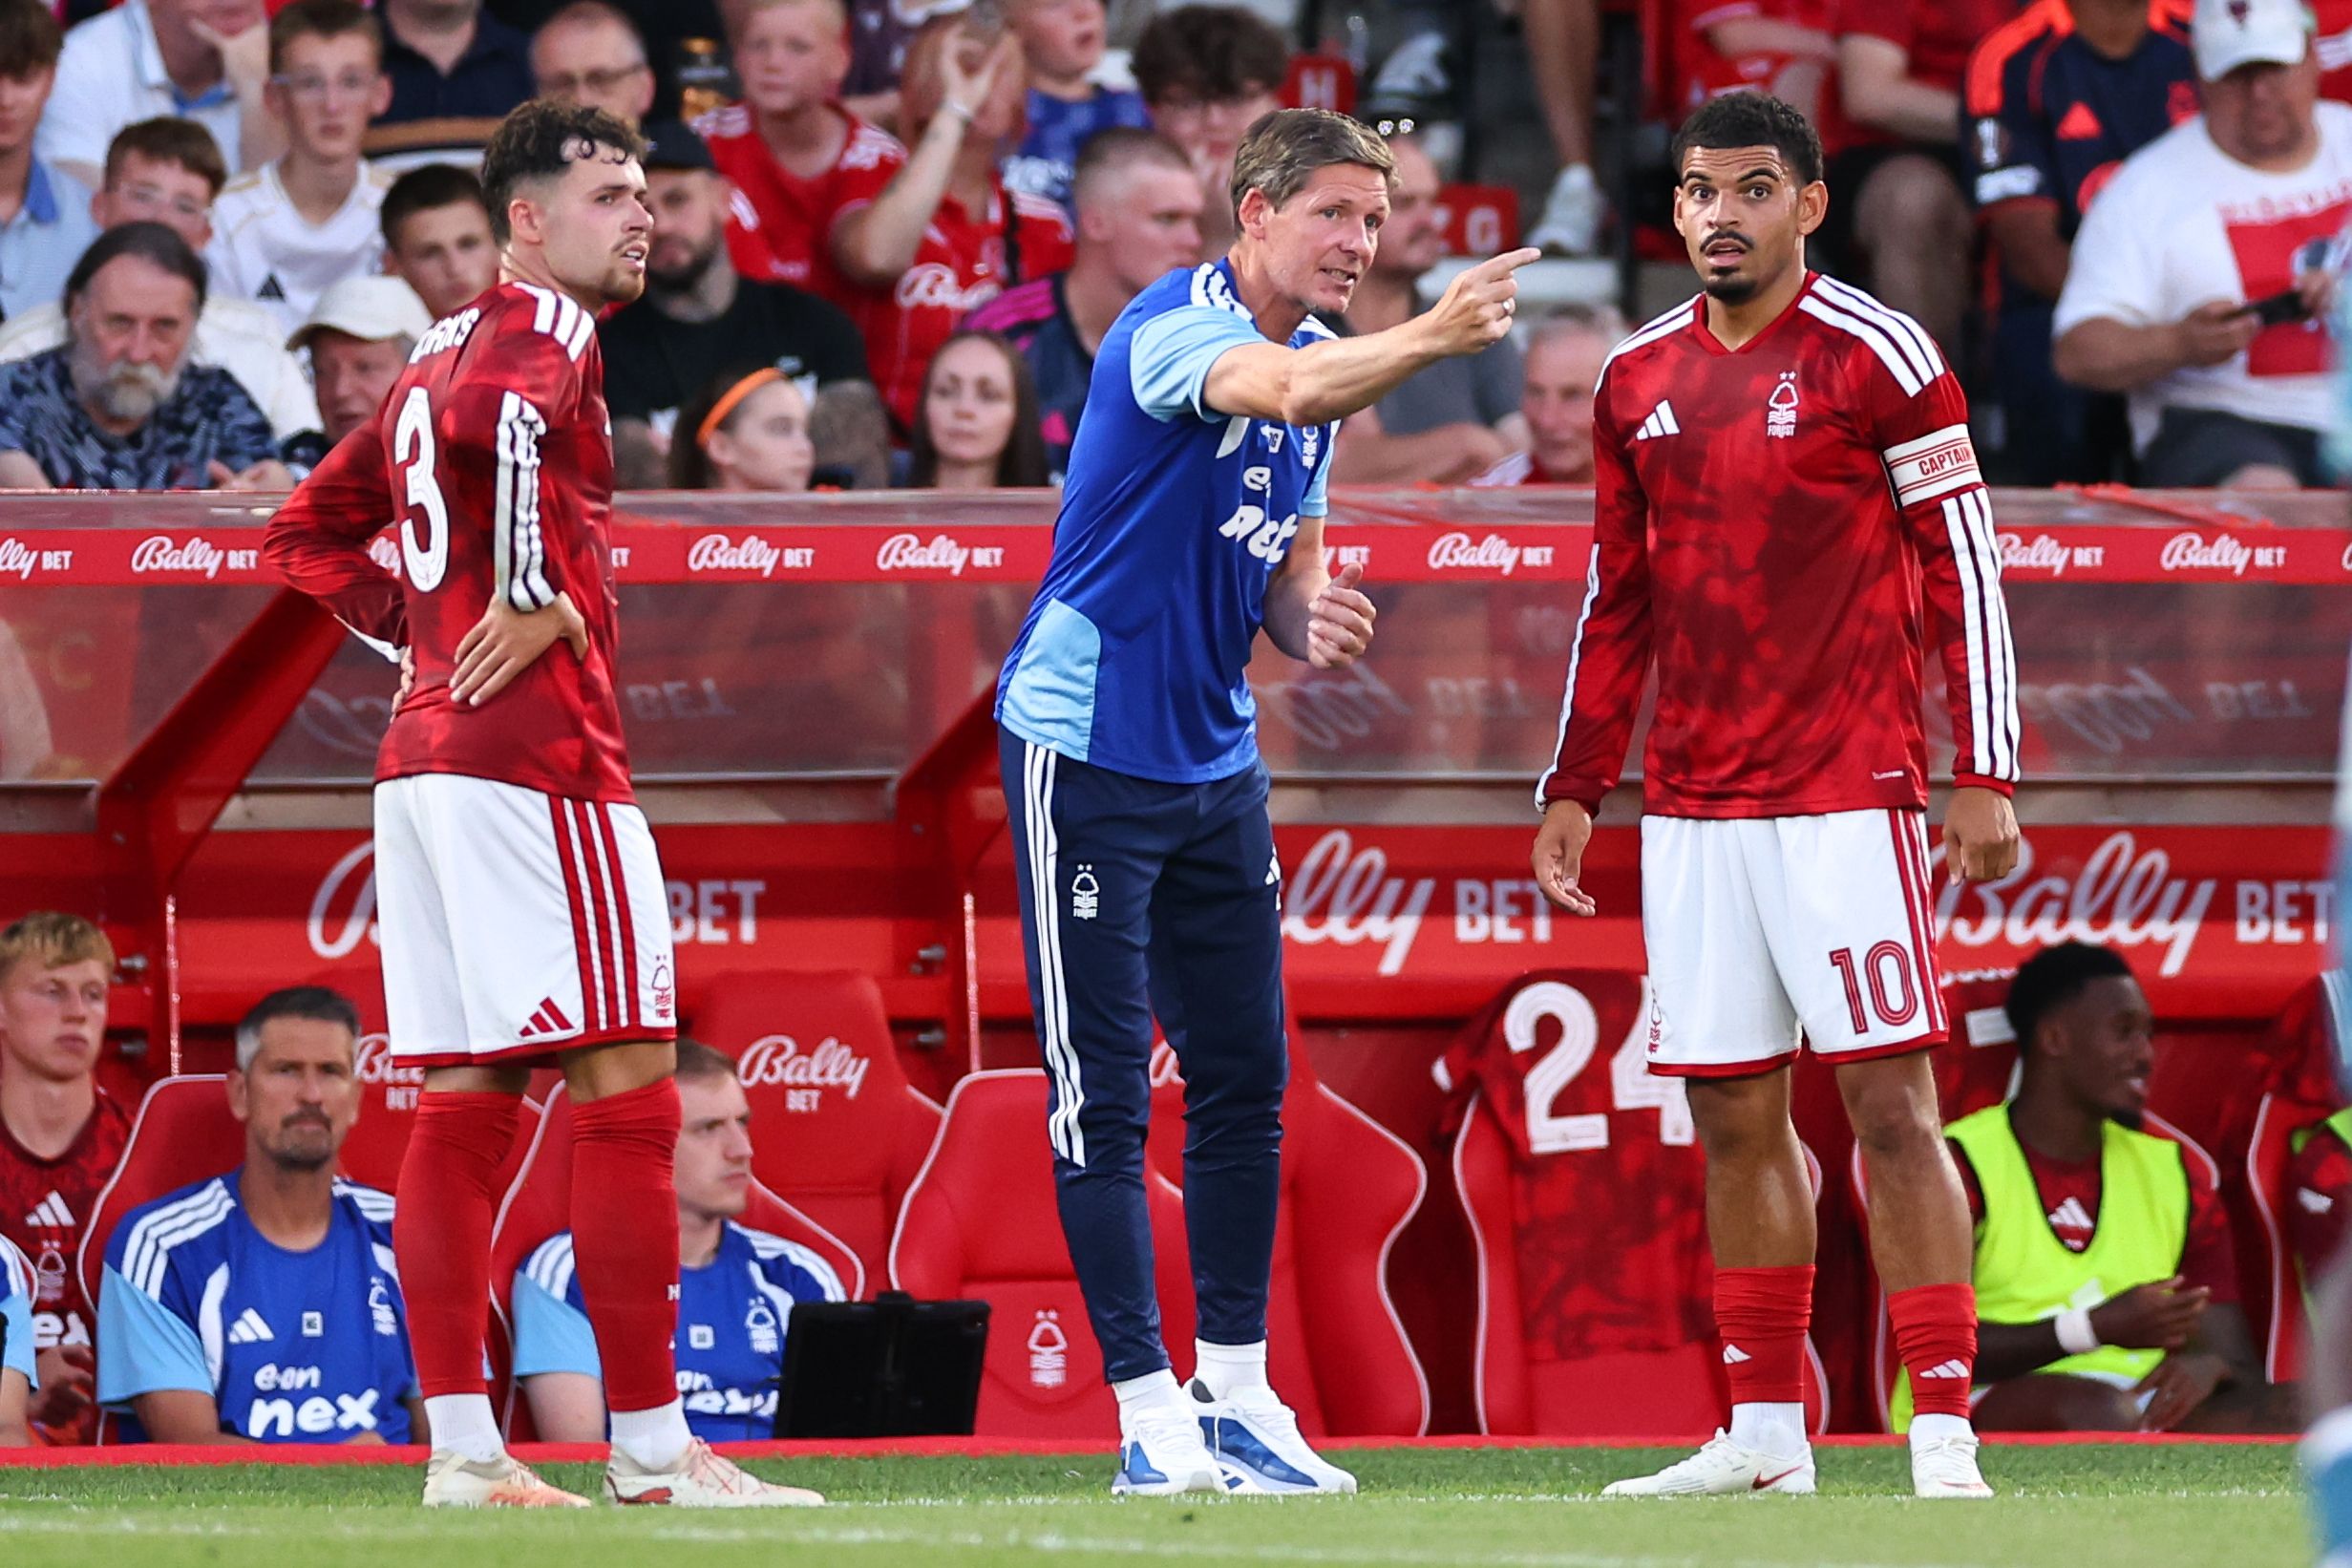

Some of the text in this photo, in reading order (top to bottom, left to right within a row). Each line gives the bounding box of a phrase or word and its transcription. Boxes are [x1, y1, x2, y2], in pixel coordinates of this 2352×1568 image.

[1918, 446, 1972, 476] CAPTAIN
[394, 386, 449, 592] 3
[0, 538, 73, 580] lly BET
[131, 536, 258, 579] Bally BET
[611, 547, 631, 567] ET
[688, 534, 815, 578] Bally BET
[877, 534, 1004, 576] Bally BET
[1339, 545, 1369, 565] BET
[1428, 532, 1554, 575] Bally BET
[2073, 546, 2104, 566] BET
[2160, 532, 2286, 576] Bally BET
[666, 880, 766, 944] BET
[1281, 829, 1553, 976] lly BET
[2235, 879, 2338, 944] BET
[1830, 940, 1918, 1034] 10
[737, 1034, 870, 1099] Bally
[1504, 974, 1696, 1155] 24
[786, 1088, 821, 1112] BET
